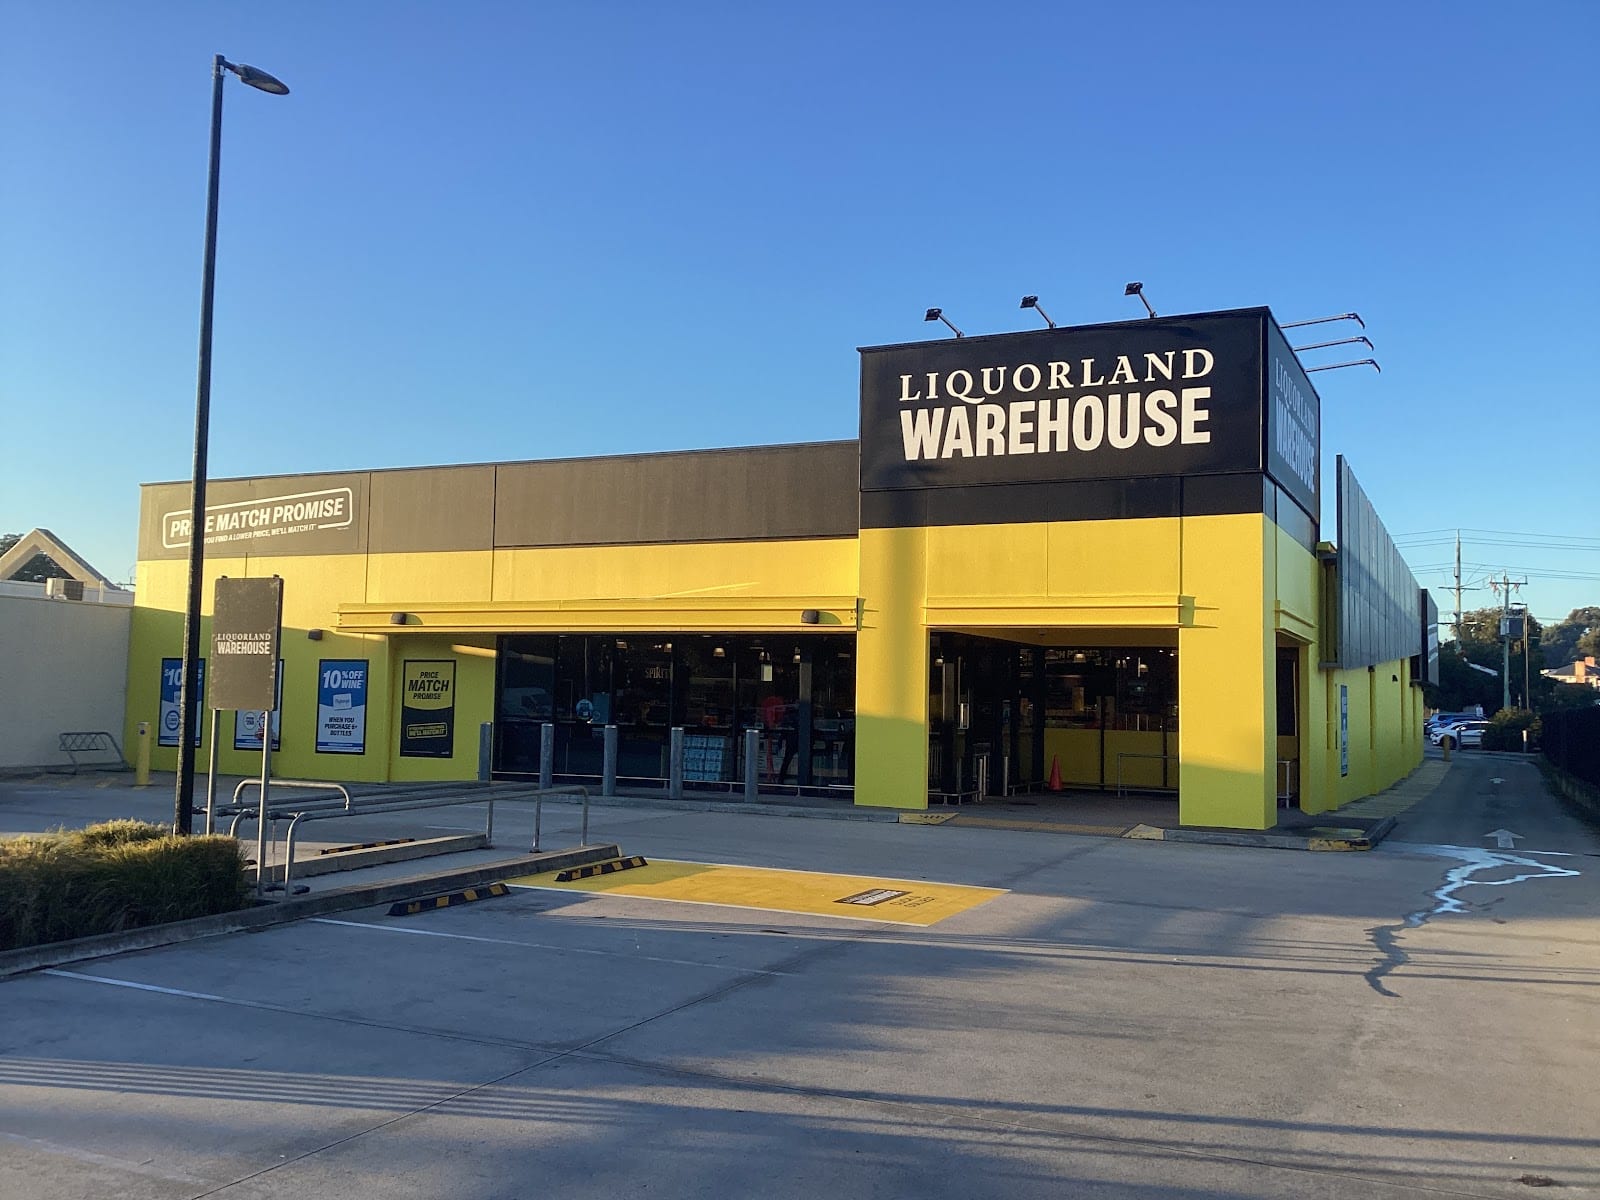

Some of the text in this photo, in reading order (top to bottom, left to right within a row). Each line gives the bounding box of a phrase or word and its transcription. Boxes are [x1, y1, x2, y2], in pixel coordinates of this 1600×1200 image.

[899, 348, 1215, 405] LIQUORLAND
[1275, 357, 1315, 439] LIQUORLAND
[899, 386, 1212, 461] WAREHOUSE
[1275, 395, 1315, 494] WAREHOUSE
[170, 497, 345, 538] PRE MATCH PROMISE
[233, 531, 252, 541] LOWER
[287, 524, 308, 534] MATCH
[217, 633, 271, 642] LIQUORLAND
[217, 641, 271, 655] WAREHOUSE
[419, 671, 440, 679] PRICE
[341, 679, 364, 689] WINE
[408, 679, 450, 692] MATCH
[412, 692, 442, 700] PROMISE
